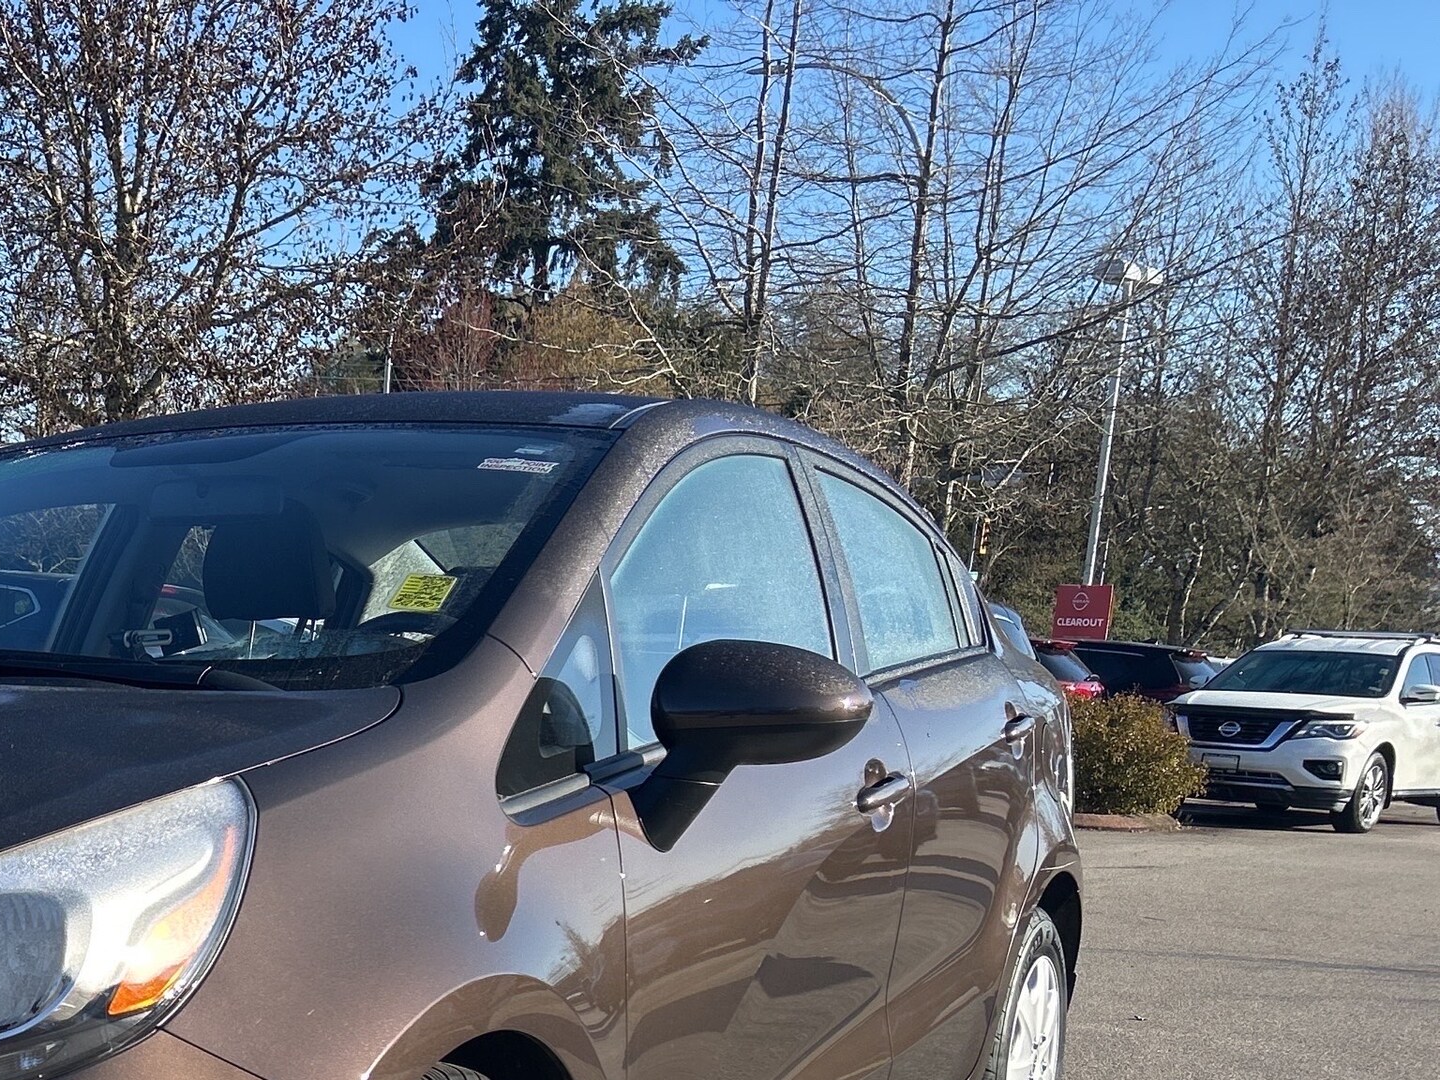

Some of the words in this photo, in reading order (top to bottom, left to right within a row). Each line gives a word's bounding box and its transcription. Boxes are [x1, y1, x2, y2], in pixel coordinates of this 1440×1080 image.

[479, 463, 551, 473] INSPECTION
[520, 460, 553, 468] POINT
[1056, 617, 1105, 628] CLEAROUT
